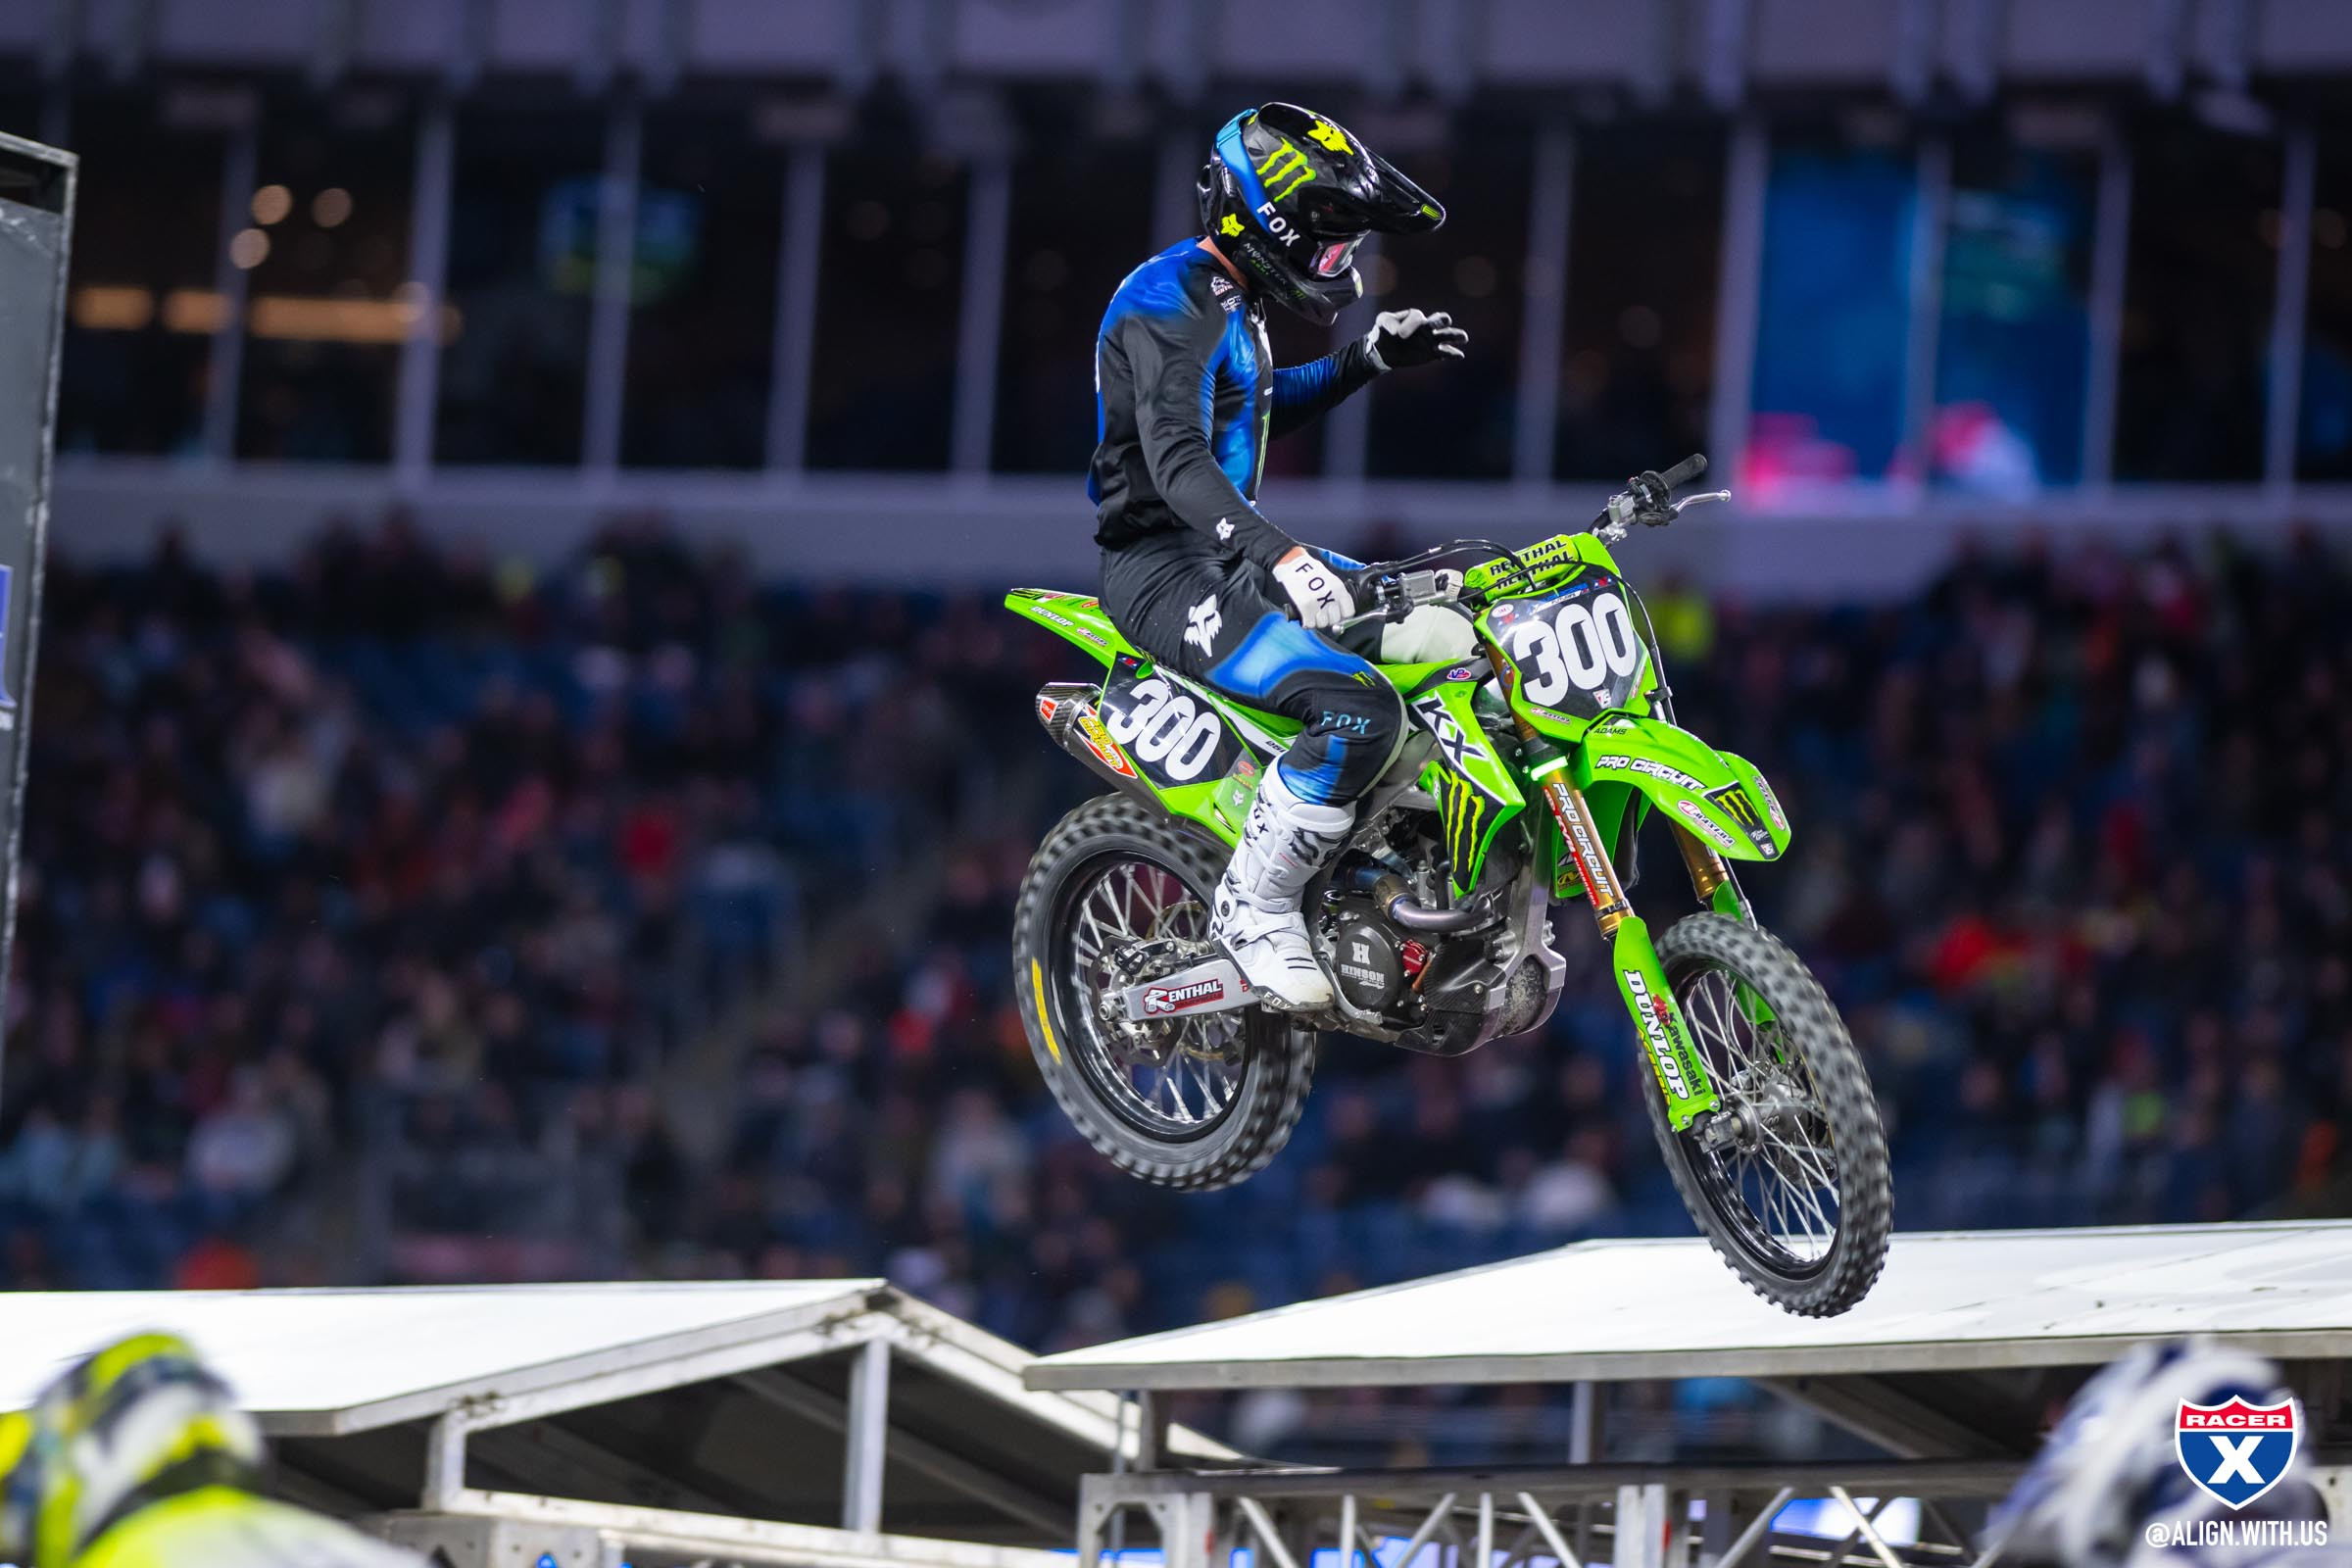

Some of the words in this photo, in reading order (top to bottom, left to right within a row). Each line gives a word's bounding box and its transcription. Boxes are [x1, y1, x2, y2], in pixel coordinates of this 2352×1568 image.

[1256, 201, 1301, 247] FOX
[1295, 563, 1335, 610] FOX
[1030, 607, 1074, 626] DUNLOP
[1513, 593, 1637, 707] 300
[1106, 679, 1221, 780] 300
[1322, 710, 1371, 735] FOX
[1414, 693, 1486, 765] KX
[1595, 756, 1631, 769] PRO
[1630, 759, 1708, 791] CIRCUIT
[1552, 783, 1582, 823] PRO
[1572, 824, 1614, 898] CIRCUIT
[1341, 964, 1384, 983] HINSON
[1352, 942, 1370, 964] H
[1145, 981, 1222, 1012] RENTHAL
[1623, 969, 1690, 1100] DUNLOP
[1668, 1012, 1706, 1097] Kawasaki
